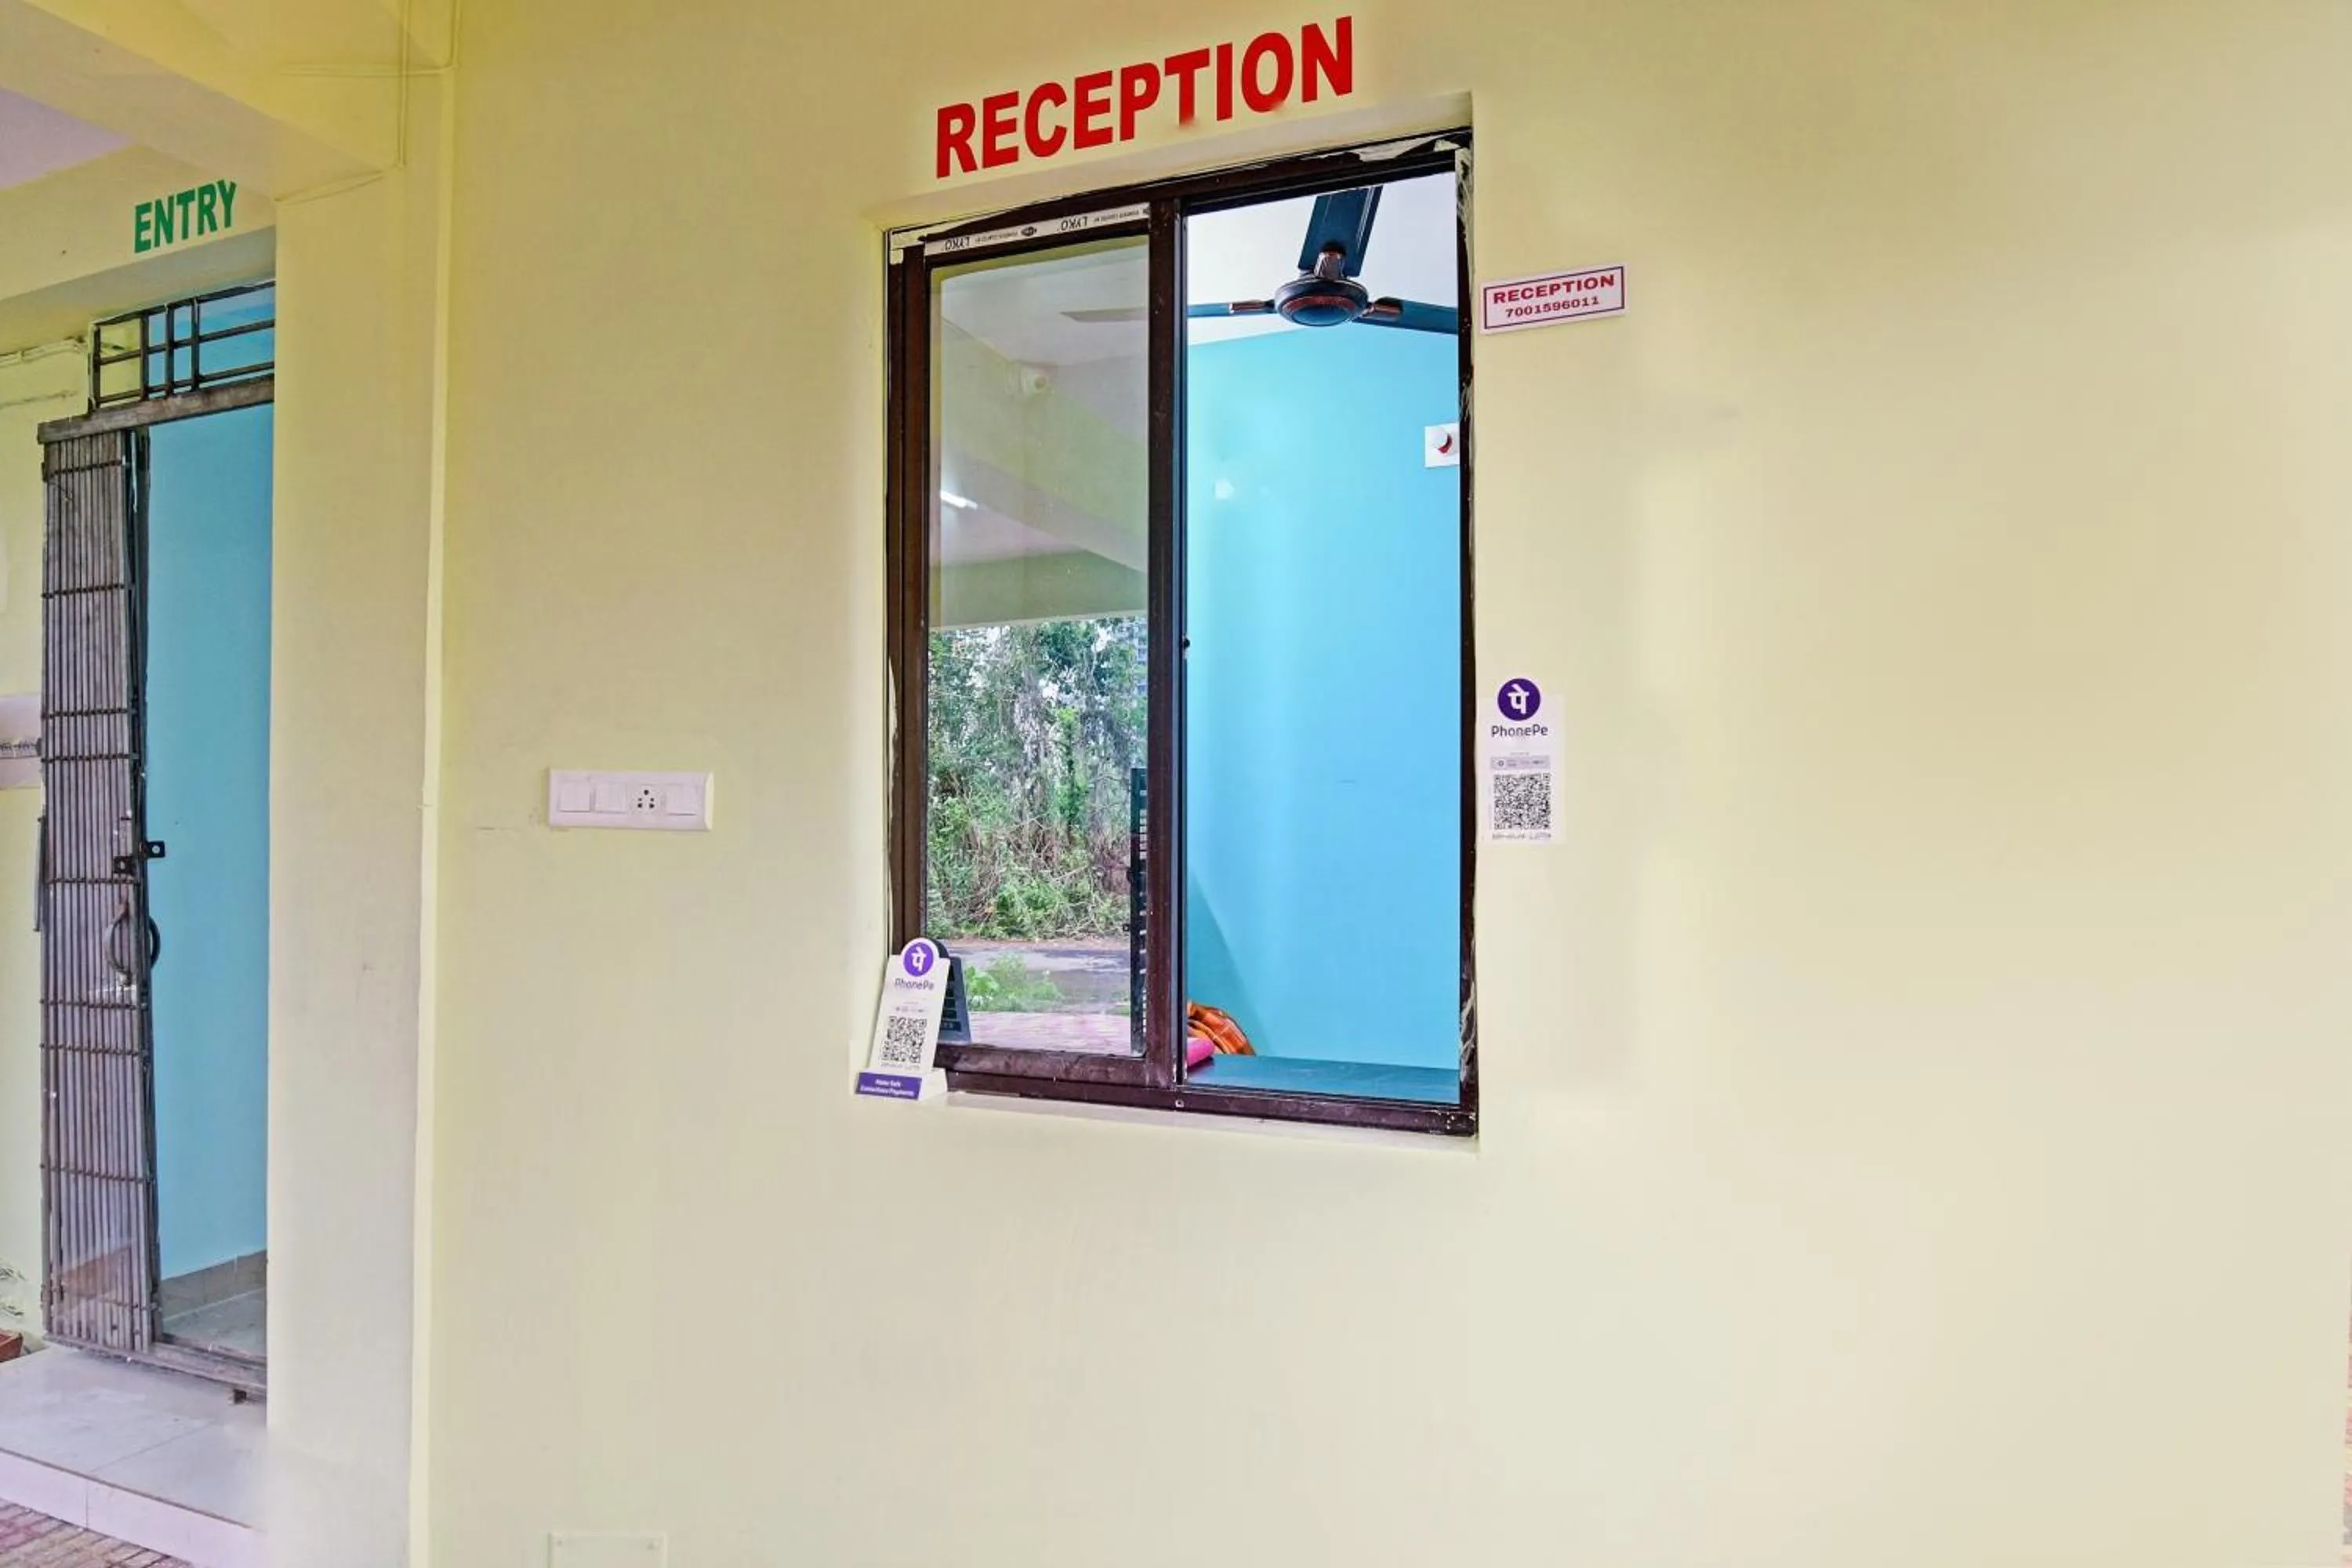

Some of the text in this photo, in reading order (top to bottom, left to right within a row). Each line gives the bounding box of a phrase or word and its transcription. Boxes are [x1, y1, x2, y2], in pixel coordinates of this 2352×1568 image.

[936, 16, 1352, 179] RECEPTION
[134, 179, 237, 254] ENTRY
[1493, 274, 1615, 304] RECEPTION
[1505, 296, 1600, 318] 7001596011
[1491, 723, 1549, 738] PhonePe
